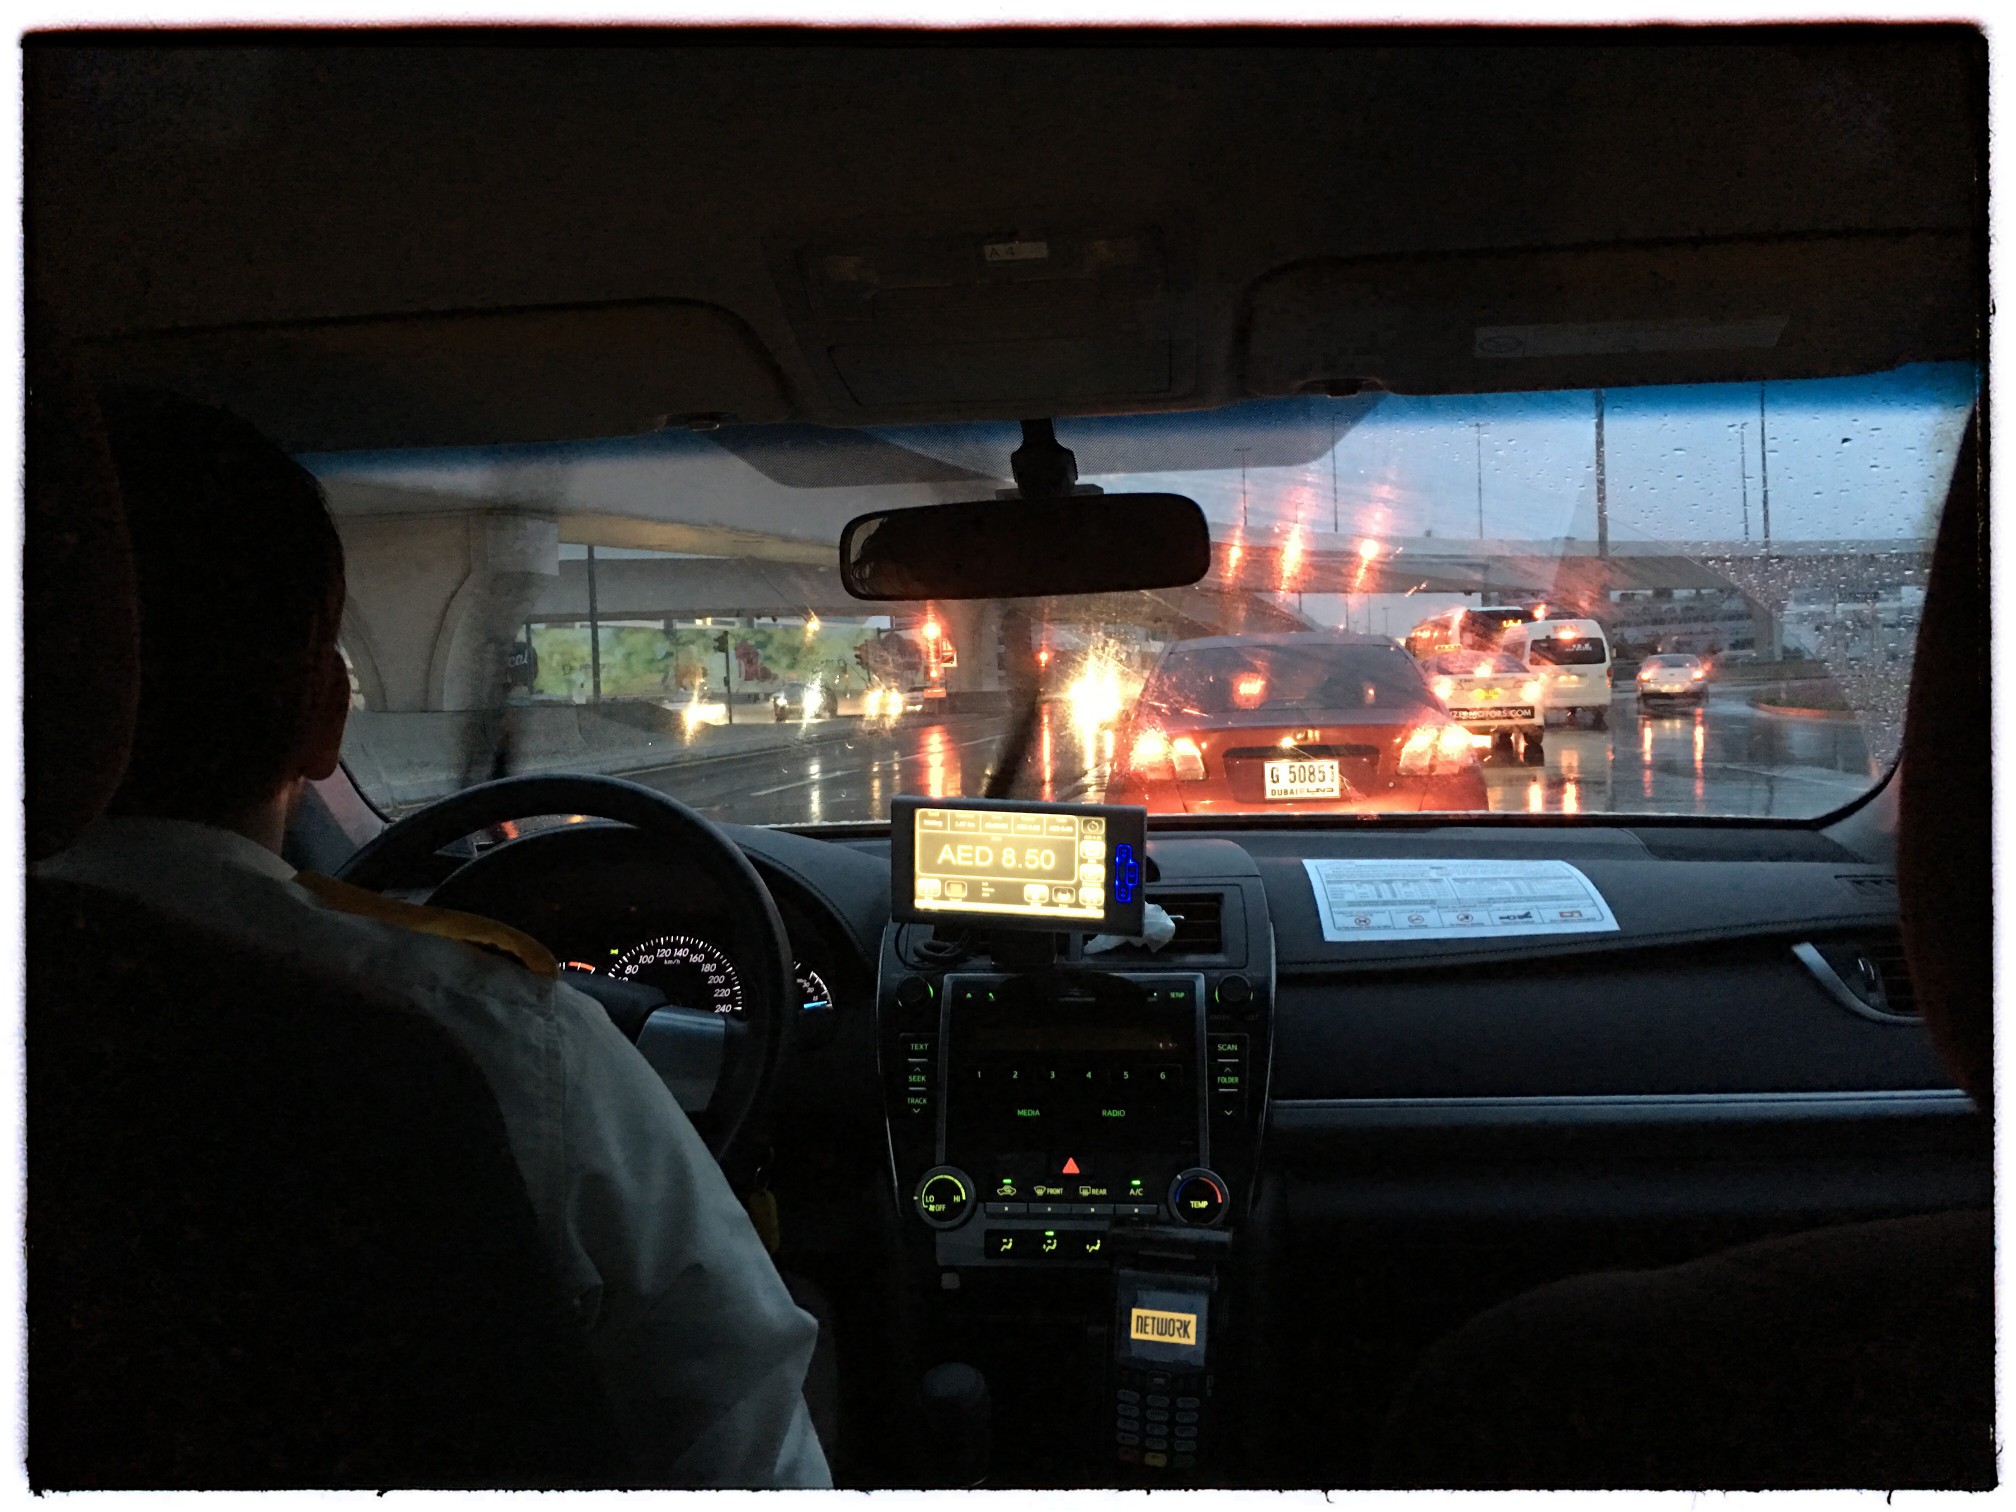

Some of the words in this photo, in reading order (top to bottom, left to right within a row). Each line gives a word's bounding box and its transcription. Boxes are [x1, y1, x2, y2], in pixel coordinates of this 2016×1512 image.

[1271, 766, 1280, 784] G
[1289, 765, 1335, 783] 50851
[1271, 788, 1298, 796] DUBAI
[937, 843, 993, 868] AED
[1002, 847, 1056, 871] 8.50
[656, 948, 672, 958] 120
[674, 948, 690, 957] 140
[638, 954, 655, 964] 100
[689, 953, 705, 963] 160
[624, 964, 639, 974] 80
[701, 963, 717, 973] 180
[708, 975, 725, 984] 200
[713, 987, 731, 997] 220
[714, 1003, 732, 1013] 240
[910, 1043, 929, 1051] TEXT
[1217, 1043, 1238, 1051] SCAN
[908, 1074, 927, 1083] SEEK
[977, 1070, 982, 1079] 1
[1012, 1070, 1019, 1079] 2
[1050, 1070, 1056, 1079] 3
[1086, 1071, 1093, 1079] 4
[1123, 1071, 1130, 1080] 5
[1159, 1071, 1166, 1080] 6
[1217, 1076, 1239, 1084] FOLDER
[907, 1097, 928, 1105] TRACK
[1017, 1108, 1040, 1117] MEDIA
[1101, 1109, 1126, 1118] RADIO
[1047, 1187, 1064, 1196] FRONT
[1091, 1188, 1108, 1196] REAR
[1129, 1187, 1143, 1196] A/C
[925, 1194, 935, 1203] LO
[952, 1194, 961, 1203] HI
[935, 1203, 946, 1212] OFF
[1189, 1200, 1209, 1209] TEMP
[1136, 1315, 1191, 1339] NETWORK
